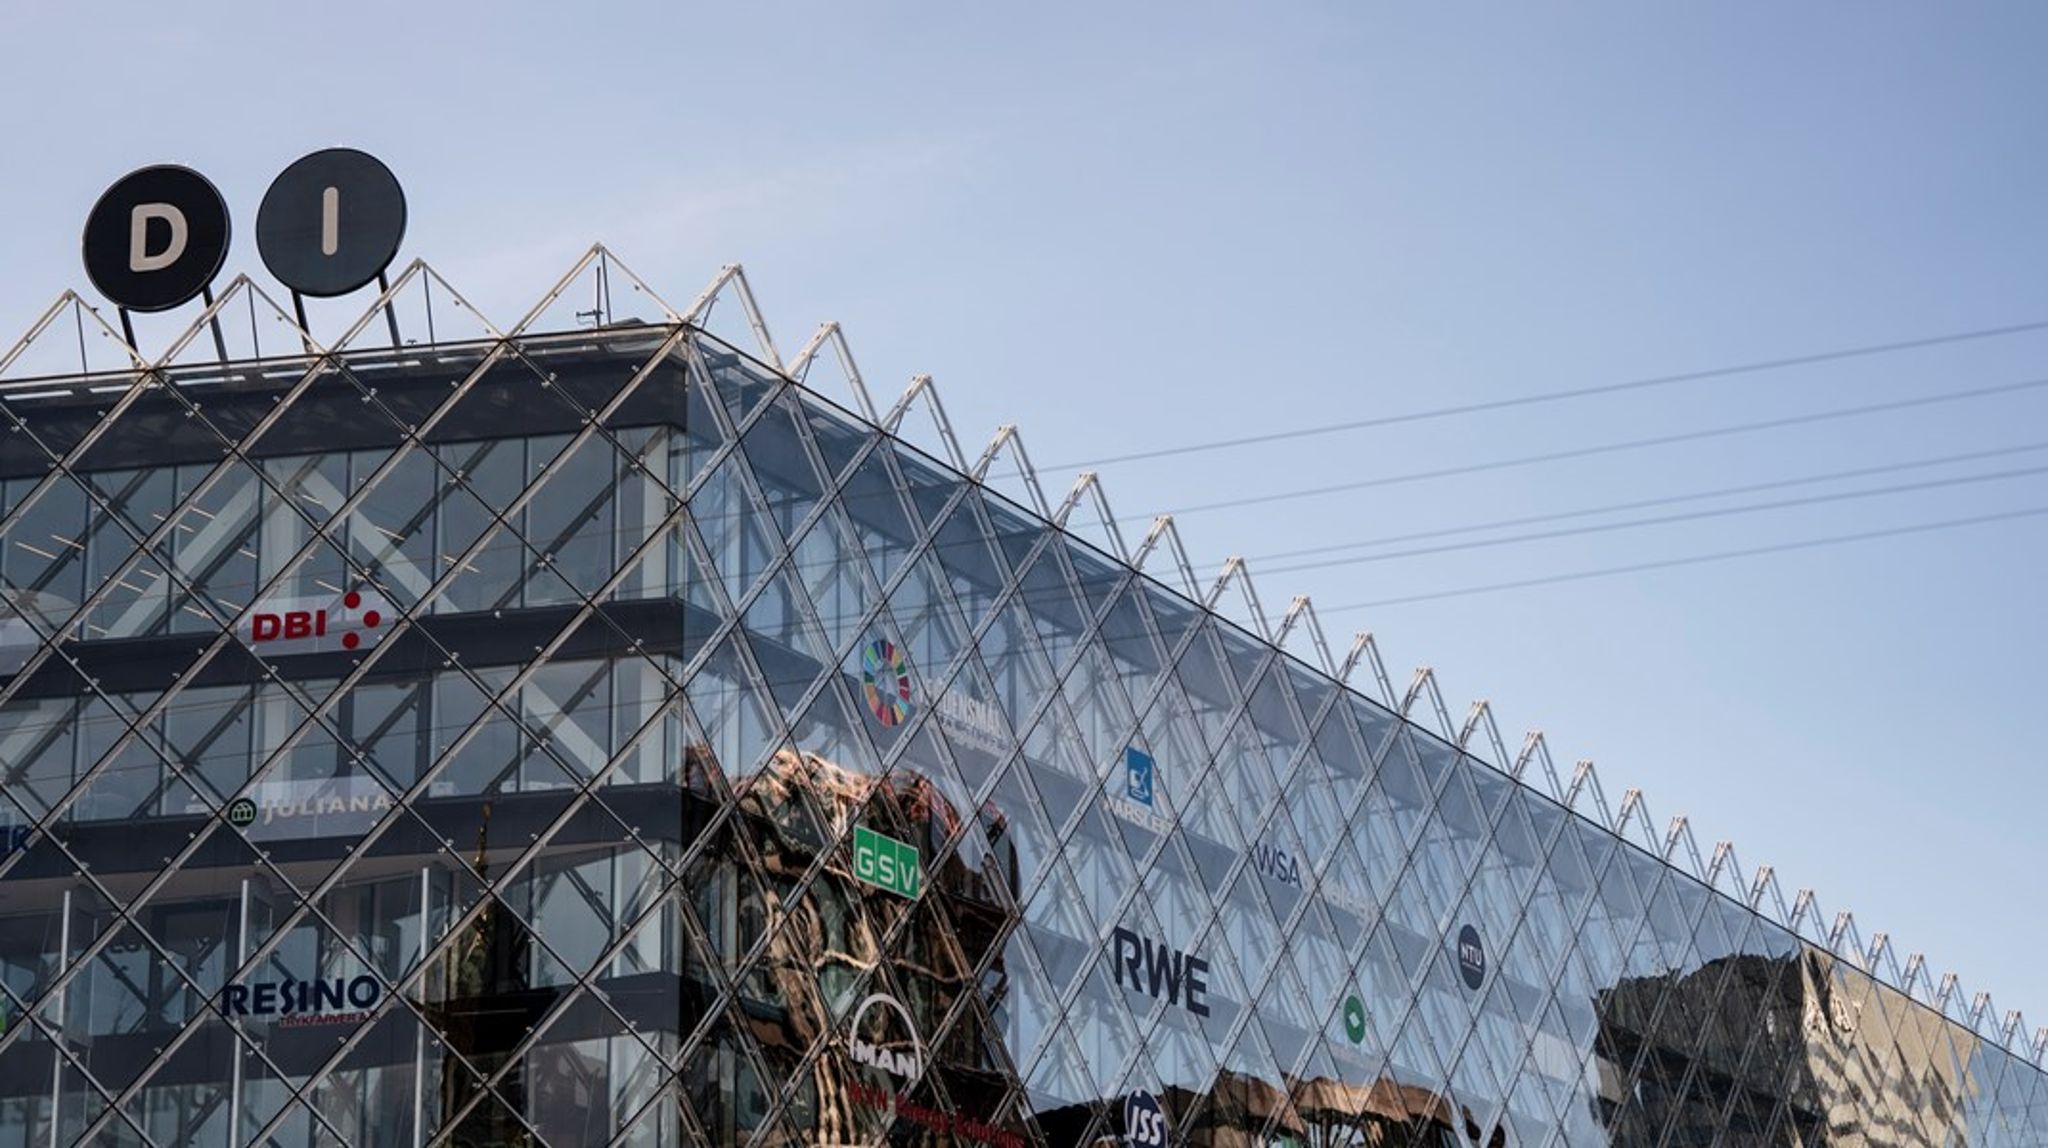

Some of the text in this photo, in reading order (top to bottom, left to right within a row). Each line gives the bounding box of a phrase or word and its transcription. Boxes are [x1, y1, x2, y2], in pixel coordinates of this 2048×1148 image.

[130, 186, 339, 272] D I
[252, 610, 327, 641] DBI
[264, 794, 388, 825] JULIANA
[858, 846, 915, 891] GSV
[1256, 842, 1302, 888] WSA
[1114, 926, 1210, 1018] RWE
[221, 975, 380, 1017] RESINO
[855, 1039, 917, 1080] MAN
[1131, 1105, 1162, 1146] ISS
